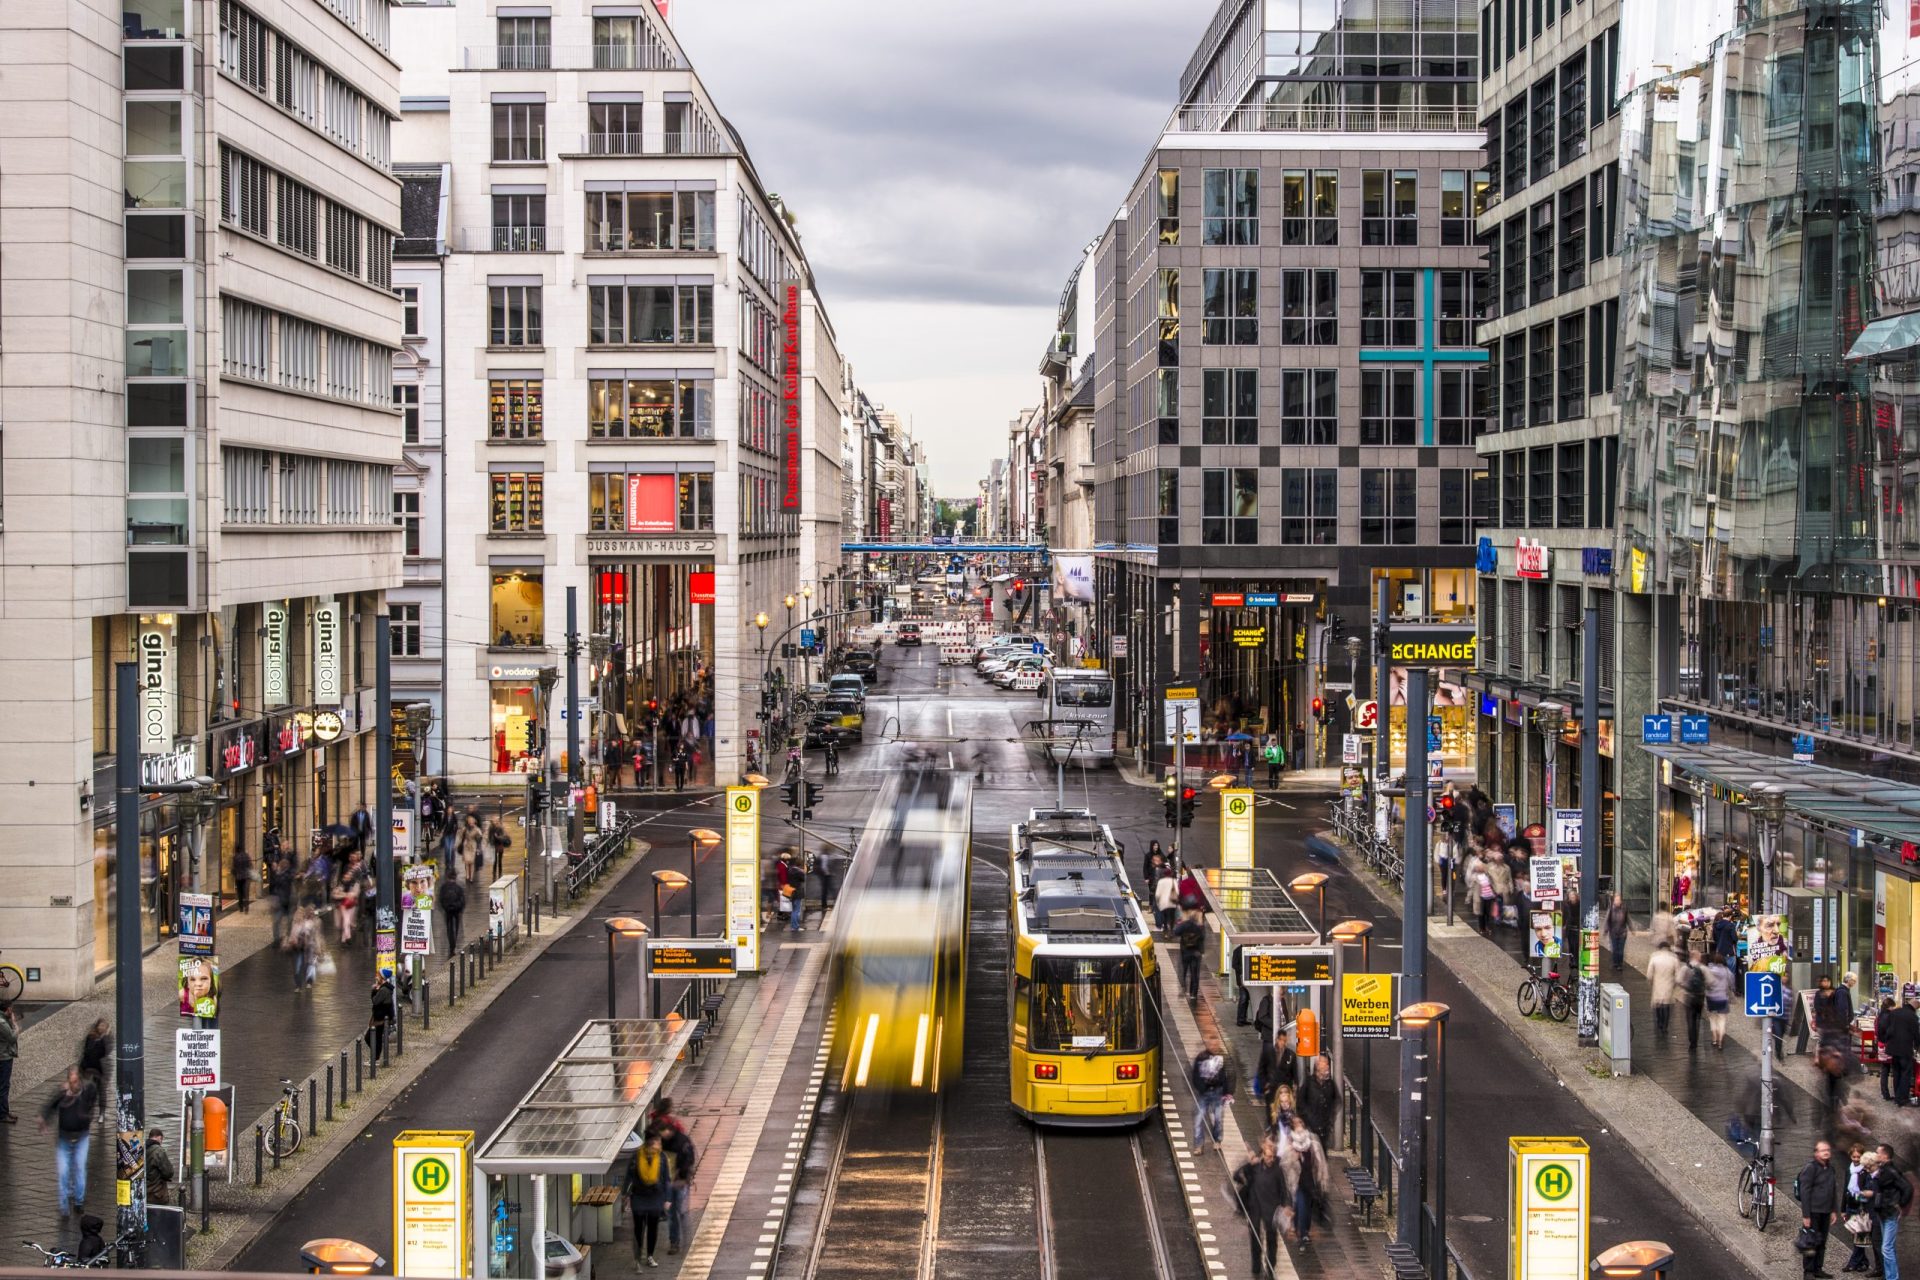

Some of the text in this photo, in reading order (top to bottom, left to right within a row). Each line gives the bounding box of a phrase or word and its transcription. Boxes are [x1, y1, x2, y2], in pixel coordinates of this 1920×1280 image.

[784, 404, 799, 429] das
[784, 431, 799, 507] Dussmann
[630, 479, 639, 526] Dussmann
[588, 542, 691, 551] DUSSMANN-HAUS
[316, 610, 336, 696] ginatricot
[1392, 644, 1473, 659] EXCHANGE
[142, 633, 168, 744] ginatricot
[180, 960, 202, 970] HELLO
[1344, 998, 1390, 1008] Werben
[1760, 983, 1774, 1005] P
[1344, 1013, 1389, 1022] Laternen!
[182, 1033, 196, 1041] Nicht
